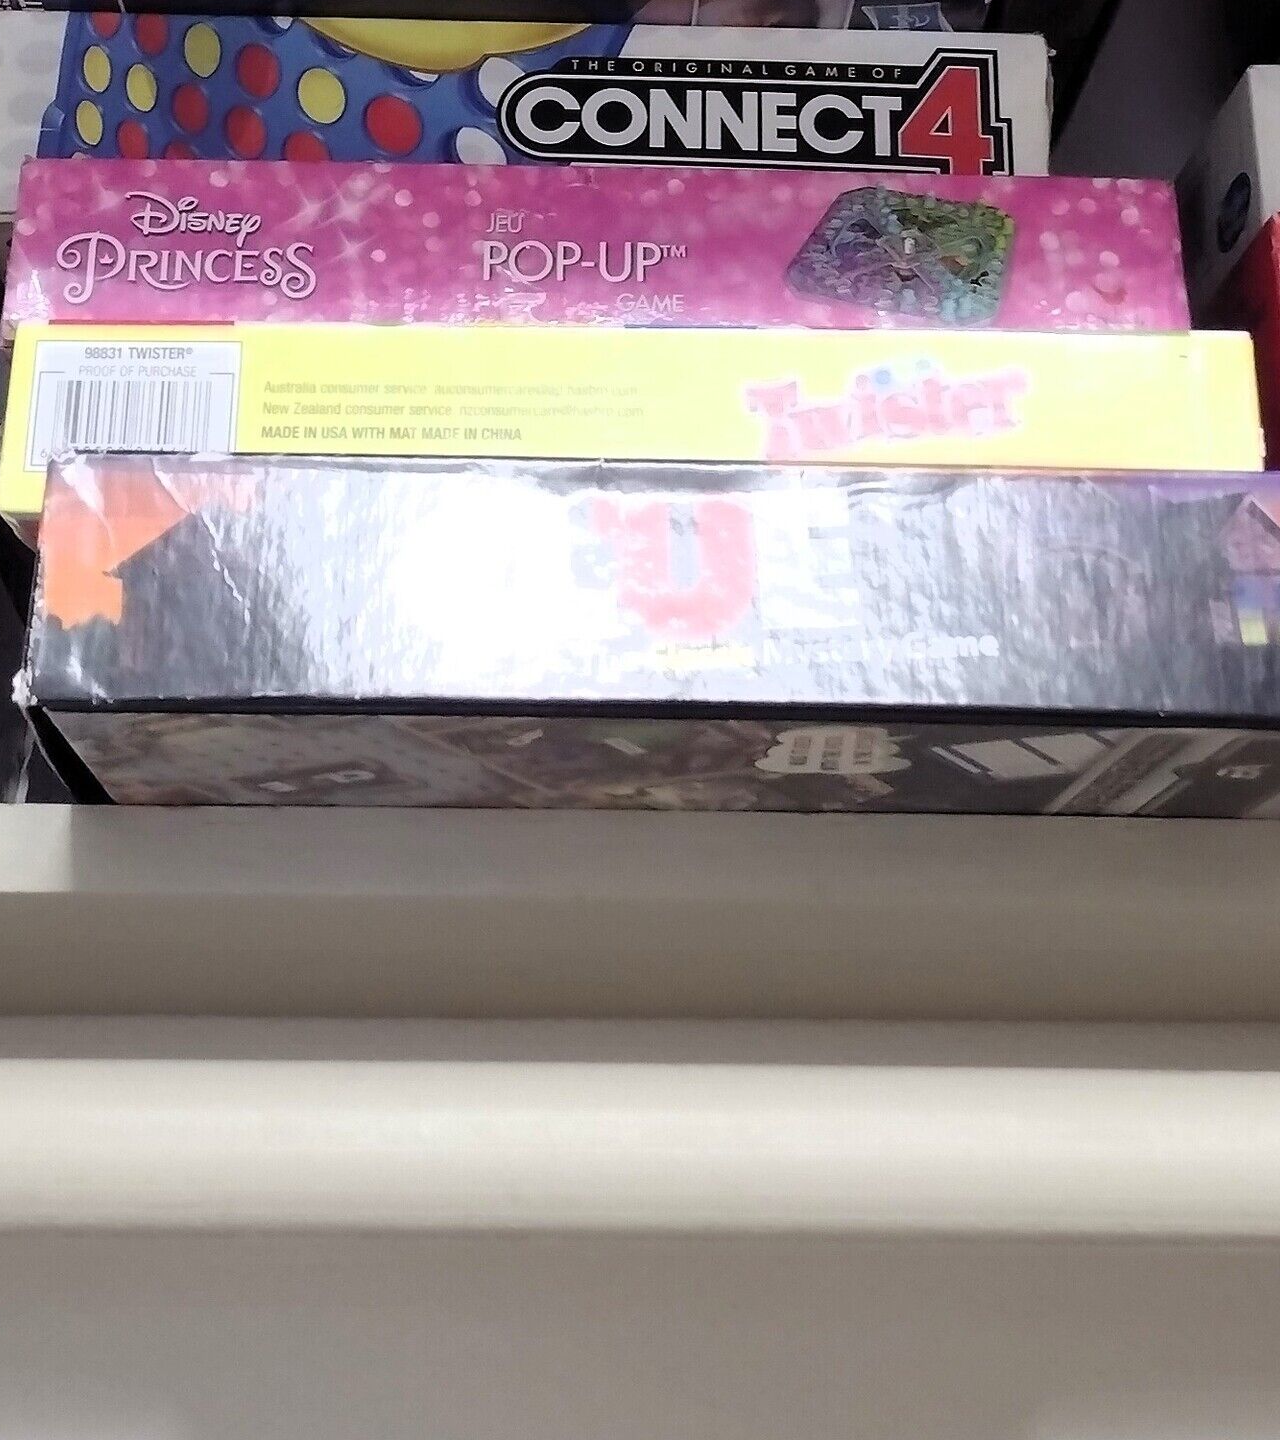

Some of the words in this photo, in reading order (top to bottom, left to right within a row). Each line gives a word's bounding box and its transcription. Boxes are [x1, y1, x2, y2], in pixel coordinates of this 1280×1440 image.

[571, 59, 616, 73] THE
[631, 61, 771, 76] ORIGINAL
[784, 65, 858, 79] GAME
[872, 66, 903, 80] OF
[515, 85, 903, 157] CONNECT
[898, 65, 995, 175] 4
[486, 212, 525, 233] JEU
[57, 229, 318, 305] PRINCESS
[616, 293, 686, 314] GAME
[85, 346, 123, 360] 98831
[78, 364, 116, 378] PROOF
[119, 365, 135, 378] OF
[138, 365, 199, 379] PURCHASE
[263, 380, 318, 396] Australia
[320, 382, 380, 396] consumer
[262, 401, 289, 416] New
[293, 401, 342, 417] Zealand
[345, 403, 406, 417] consumer
[261, 426, 300, 440] MADE
[303, 426, 318, 440] IN
[321, 426, 348, 440] USA
[351, 426, 385, 440] WITH
[389, 426, 418, 440] MAT
[421, 426, 460, 441] MADE
[463, 427, 478, 441] IN
[481, 427, 522, 441] CHINA
